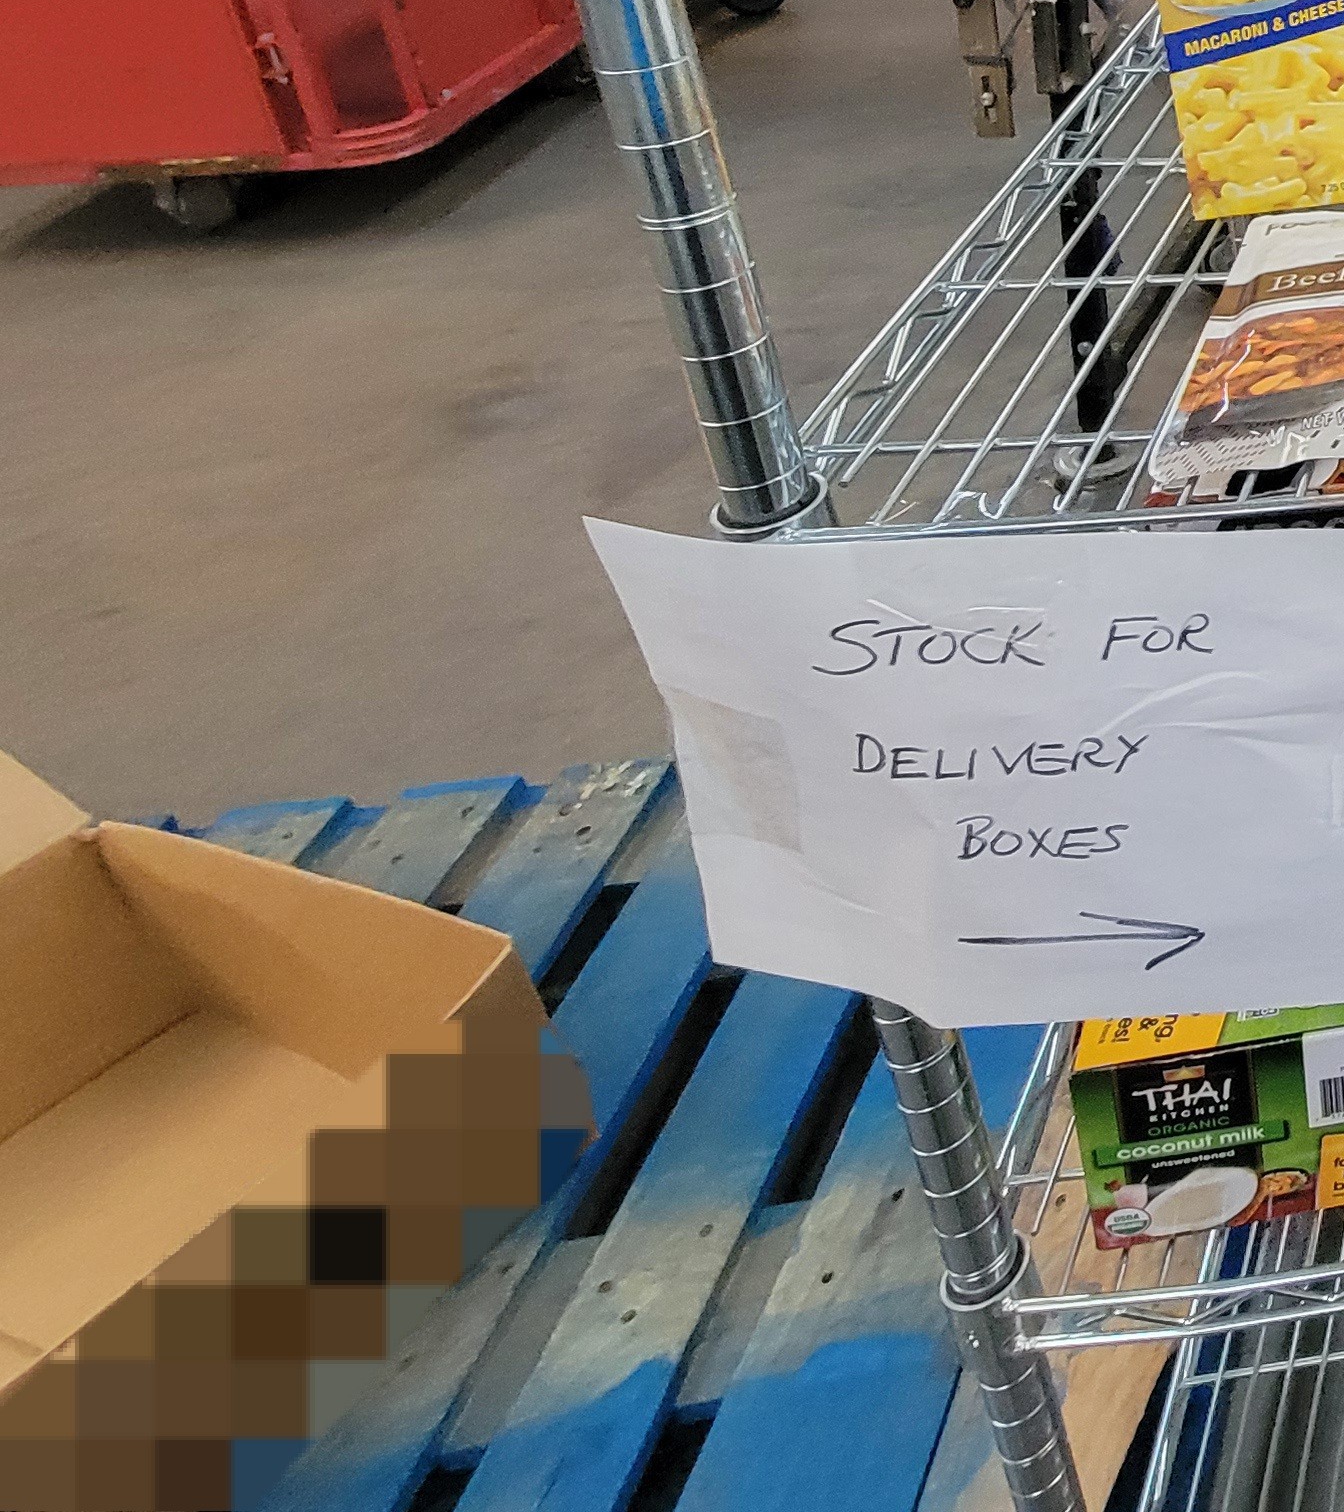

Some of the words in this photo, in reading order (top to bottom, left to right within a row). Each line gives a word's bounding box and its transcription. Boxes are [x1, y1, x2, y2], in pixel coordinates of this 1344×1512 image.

[1184, 17, 1270, 59] MACARONI
[1272, 16, 1285, 33] &
[1300, 413, 1332, 431] NET
[811, 619, 1046, 676] STOCK
[1101, 612, 1214, 662] FOR
[853, 732, 1150, 780] DELIVERY
[956, 815, 1130, 860] BOXES
[1131, 1077, 1232, 1114] THAI
[1116, 1134, 1214, 1161] coconut
[1219, 1126, 1265, 1146] milk
